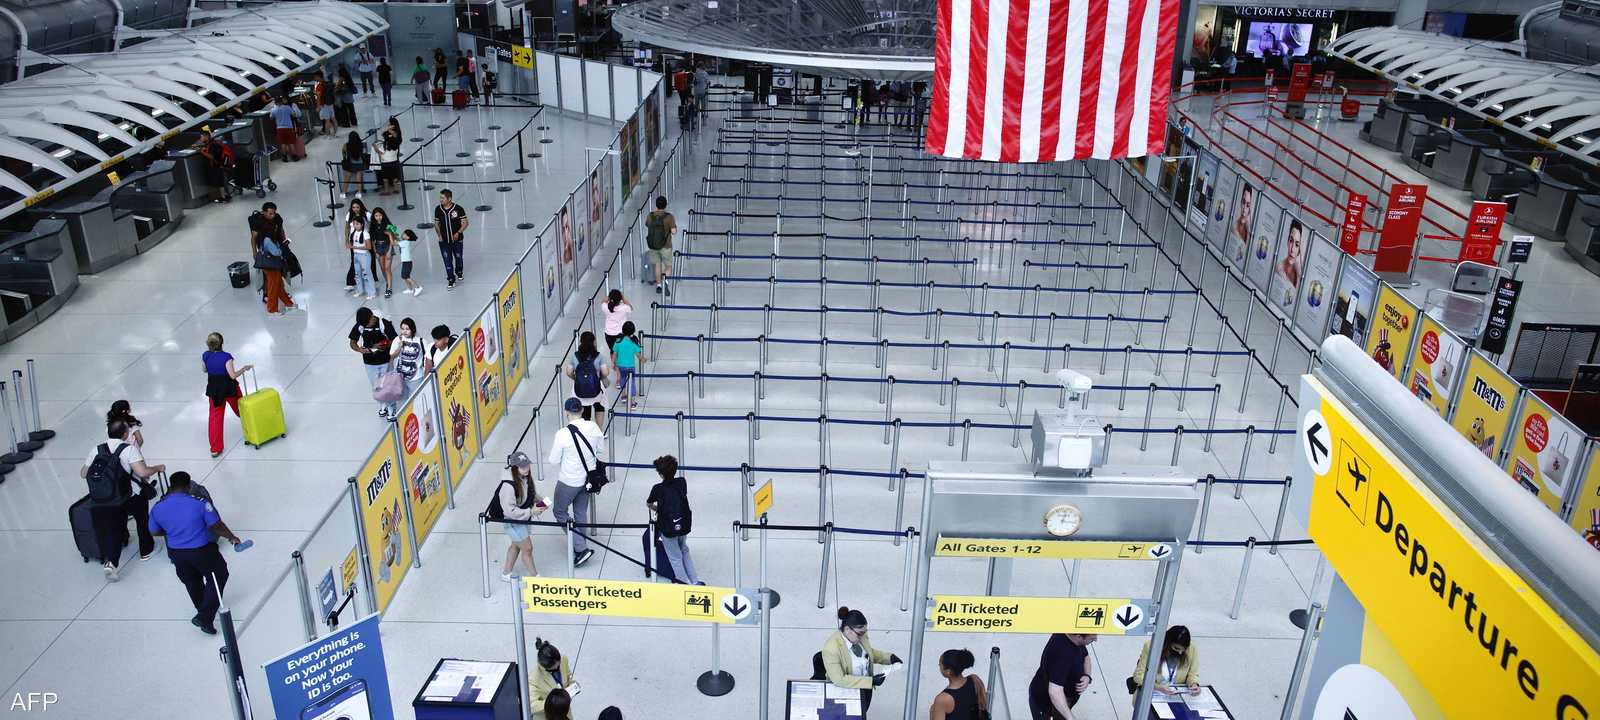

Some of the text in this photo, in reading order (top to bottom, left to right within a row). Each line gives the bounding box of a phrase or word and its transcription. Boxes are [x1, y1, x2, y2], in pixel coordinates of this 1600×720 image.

[1234, 6, 1335, 18] VICTORIA'S SECRET
[1382, 312, 1403, 333] together
[1384, 303, 1402, 321] enjoy
[1472, 376, 1505, 412] M&M's
[367, 457, 391, 507] M&M's
[941, 543, 1041, 553] All Gates 1-12
[532, 584, 642, 598] Priority Ticketed
[1375, 491, 1539, 701] Departure
[533, 596, 607, 610] Passengers
[938, 603, 1018, 615] All Ticketed
[937, 615, 1013, 629] Passengers
[287, 631, 360, 671] Everything is
[285, 642, 366, 684] on your phone.
[302, 658, 354, 690] Now your
[307, 672, 353, 700] ID is too.
